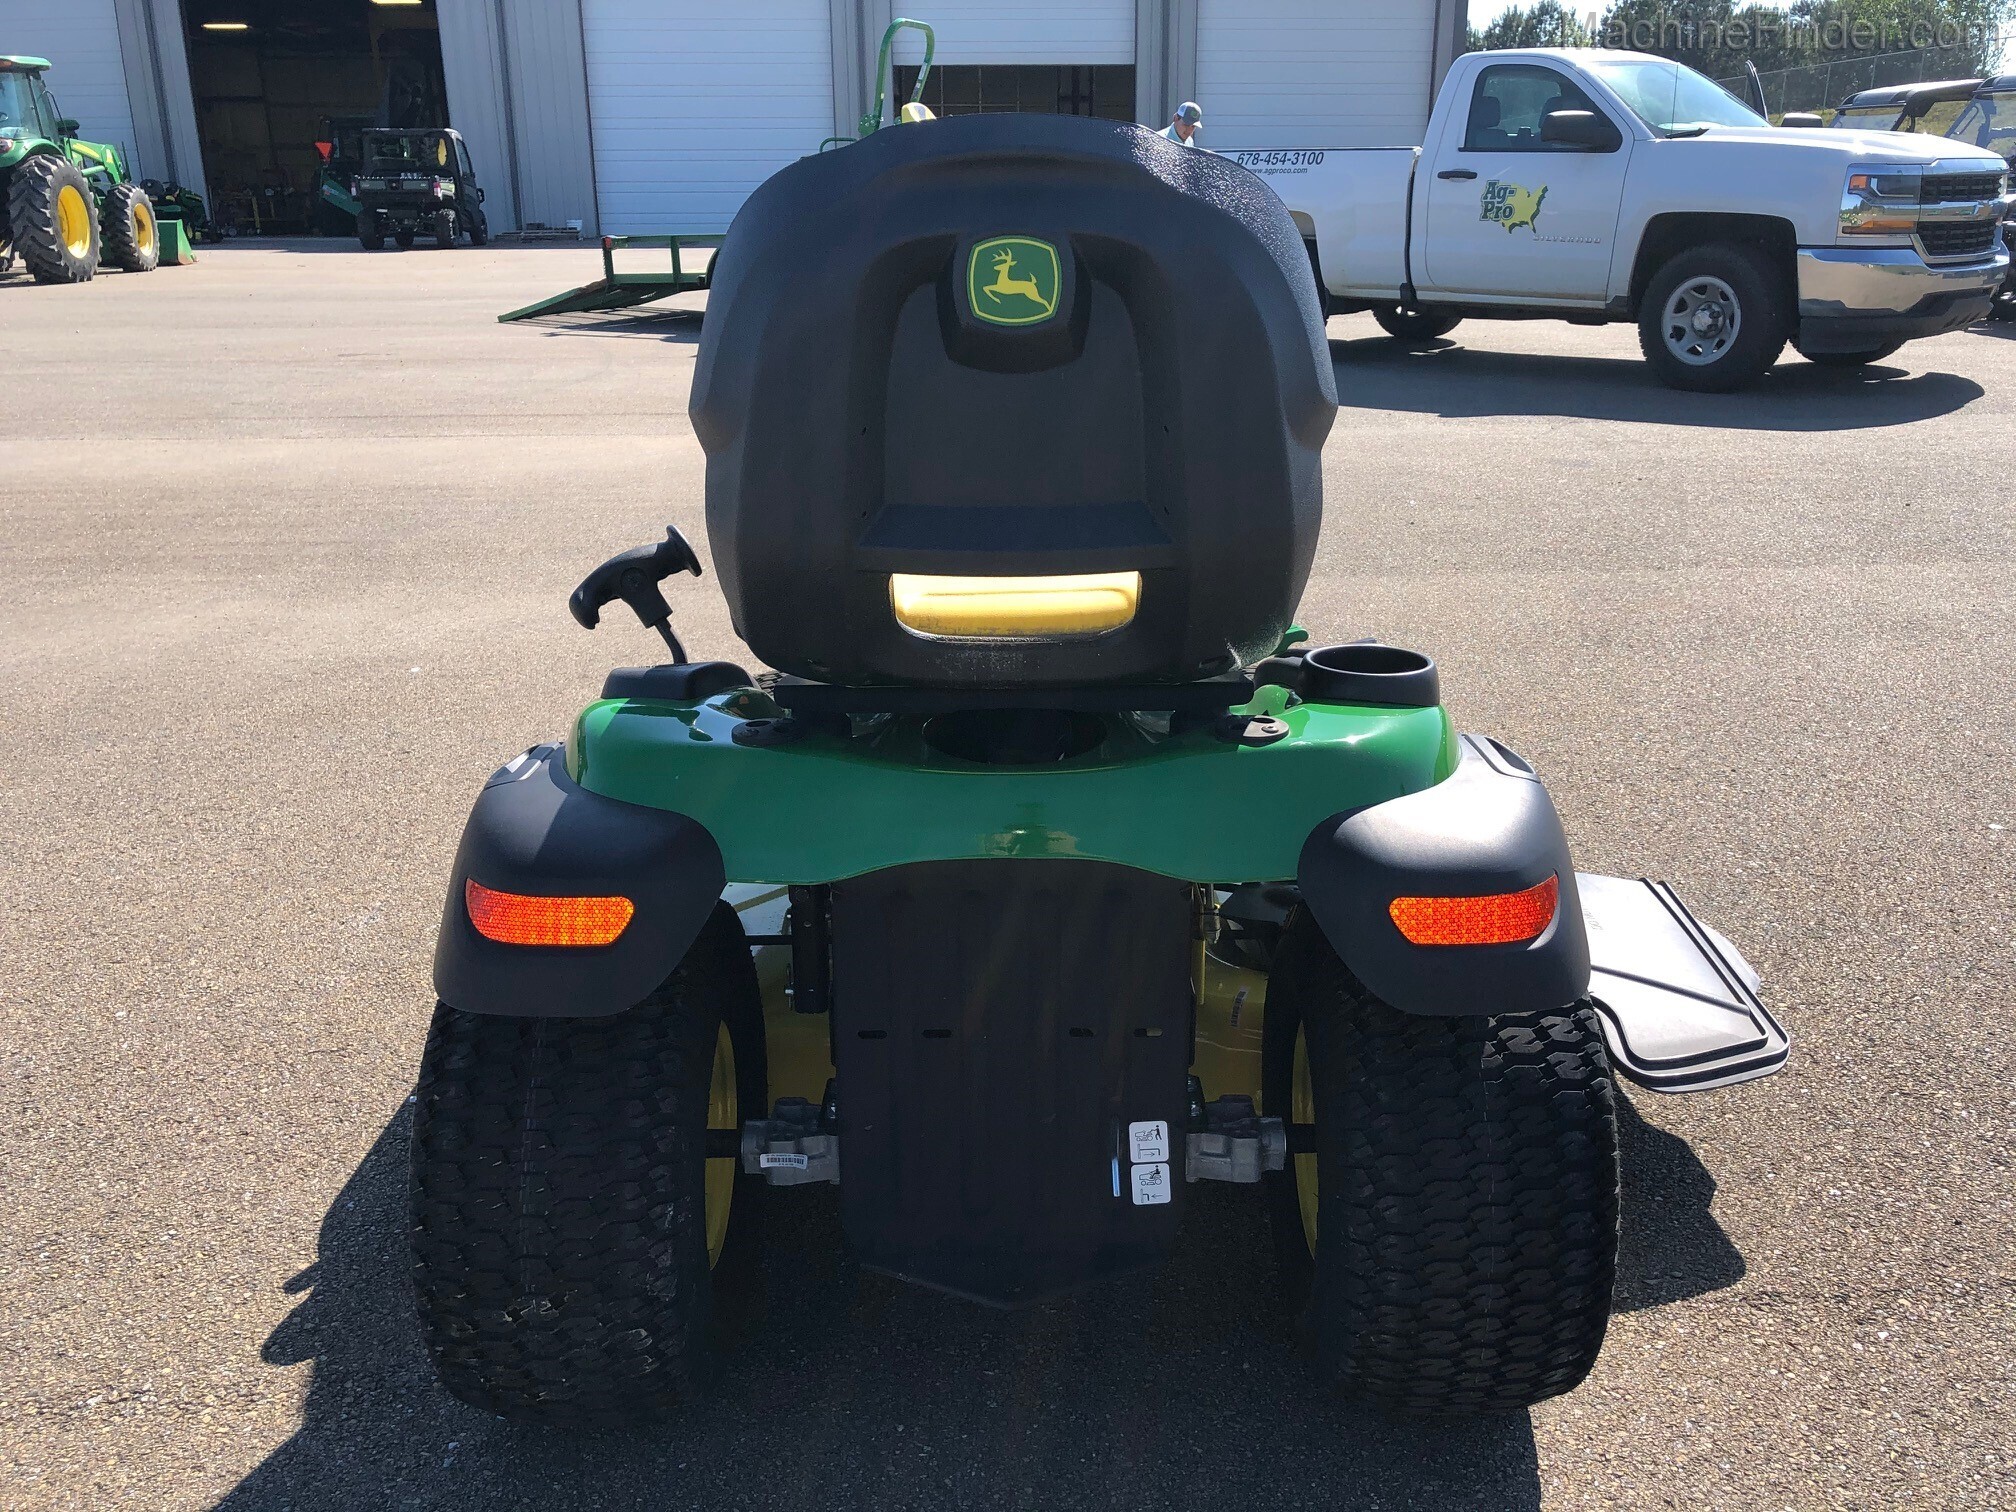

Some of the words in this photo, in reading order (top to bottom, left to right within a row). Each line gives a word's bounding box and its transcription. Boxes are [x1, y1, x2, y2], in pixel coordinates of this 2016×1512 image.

[1237, 151, 1325, 166] 678-454-3100
[1482, 180, 1516, 203] Ag-
[1480, 201, 1515, 221] Pro
